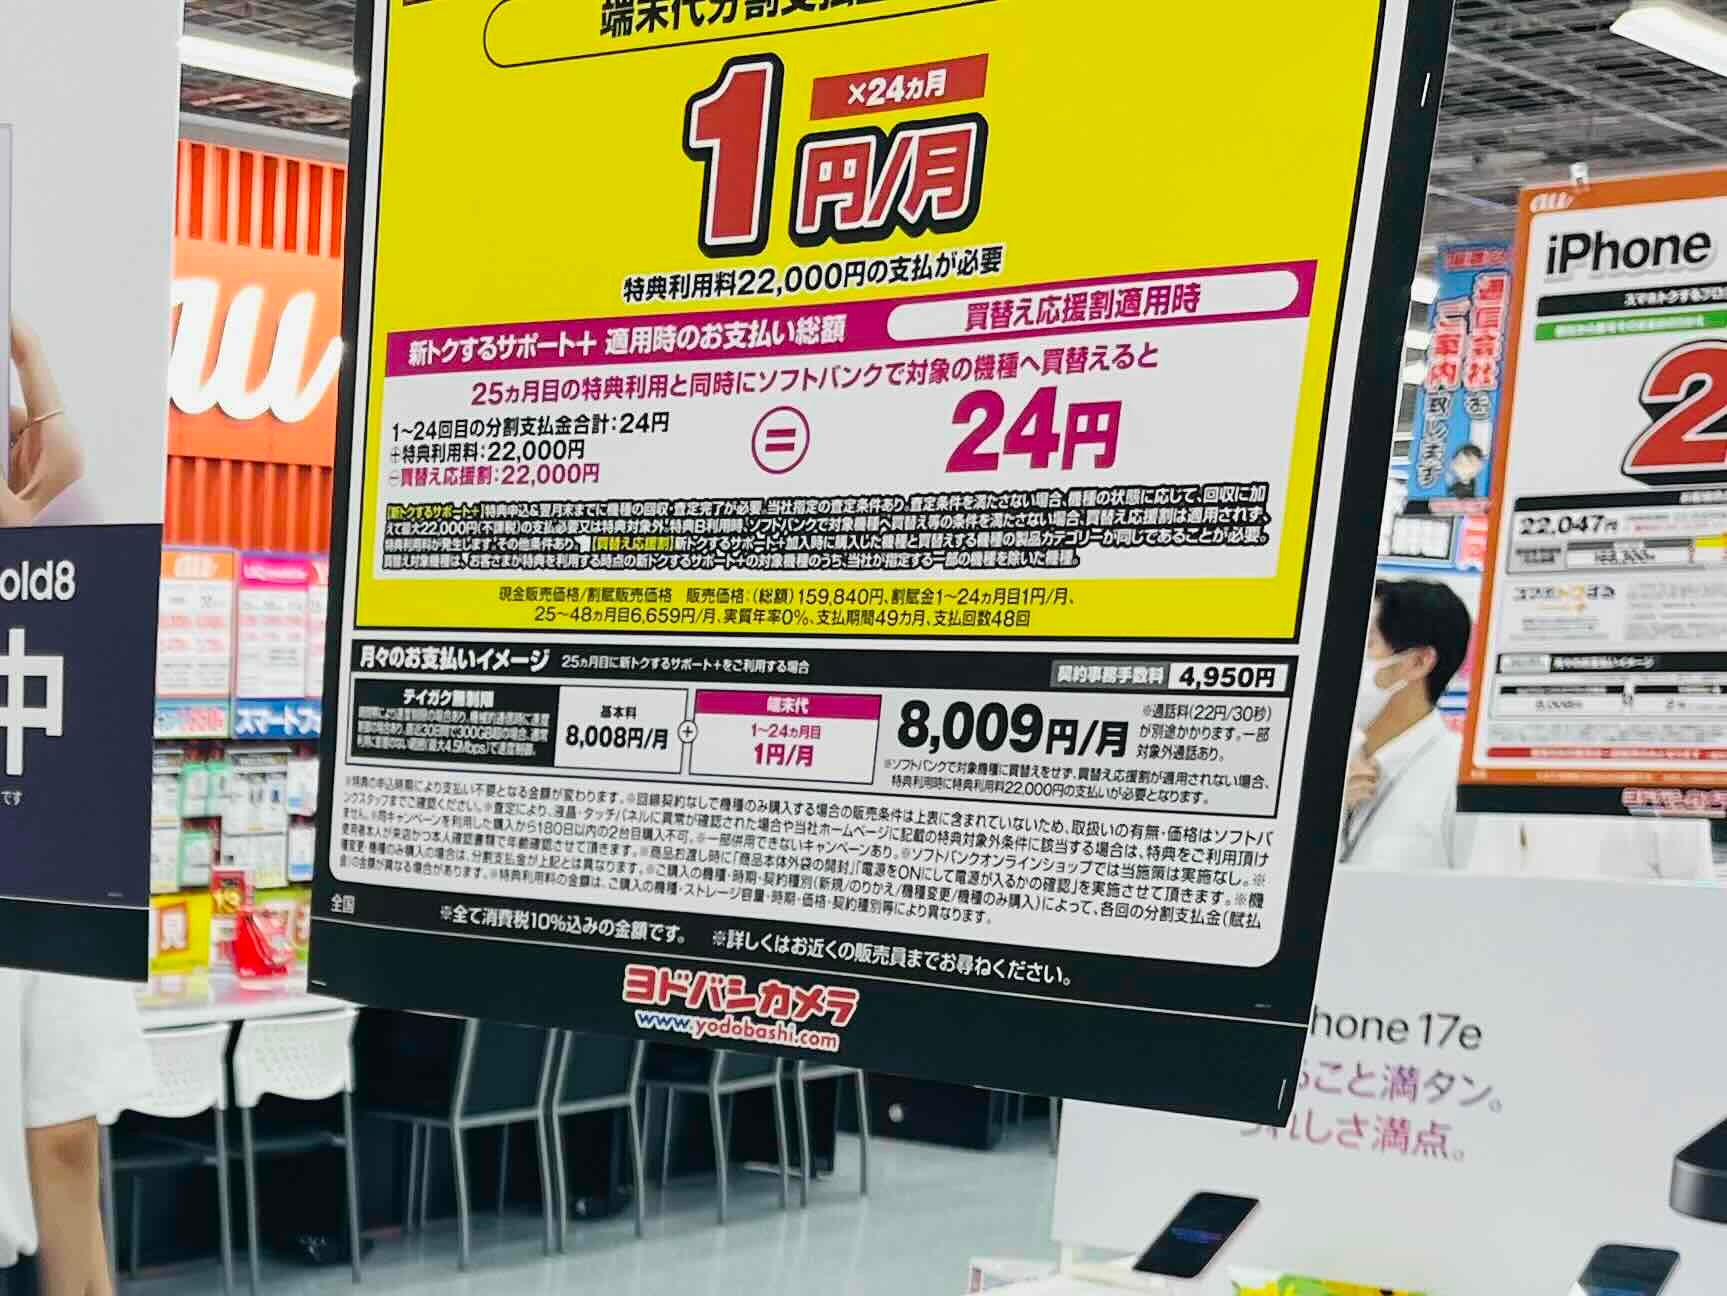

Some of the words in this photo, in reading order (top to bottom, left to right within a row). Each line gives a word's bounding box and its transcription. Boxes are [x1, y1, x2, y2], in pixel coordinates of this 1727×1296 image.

[1547, 230, 1712, 276] iPhone
[946, 386, 1121, 473] 24円
[1179, 666, 1275, 689] 4,950円
[600, 705, 637, 720] 基本料
[897, 699, 1129, 759] 8,009円/月
[566, 724, 668, 752] 8,008円/月
[754, 743, 814, 767] 1円/月
[331, 894, 355, 914] 全国
[623, 963, 860, 1027] ヨドバシカメラ
[635, 1010, 840, 1052] www.yodobashi.com
[1312, 1005, 1409, 1044] hone
[1419, 1012, 1482, 1051] 17e
[1240, 1109, 1465, 1163] しさ満点。
